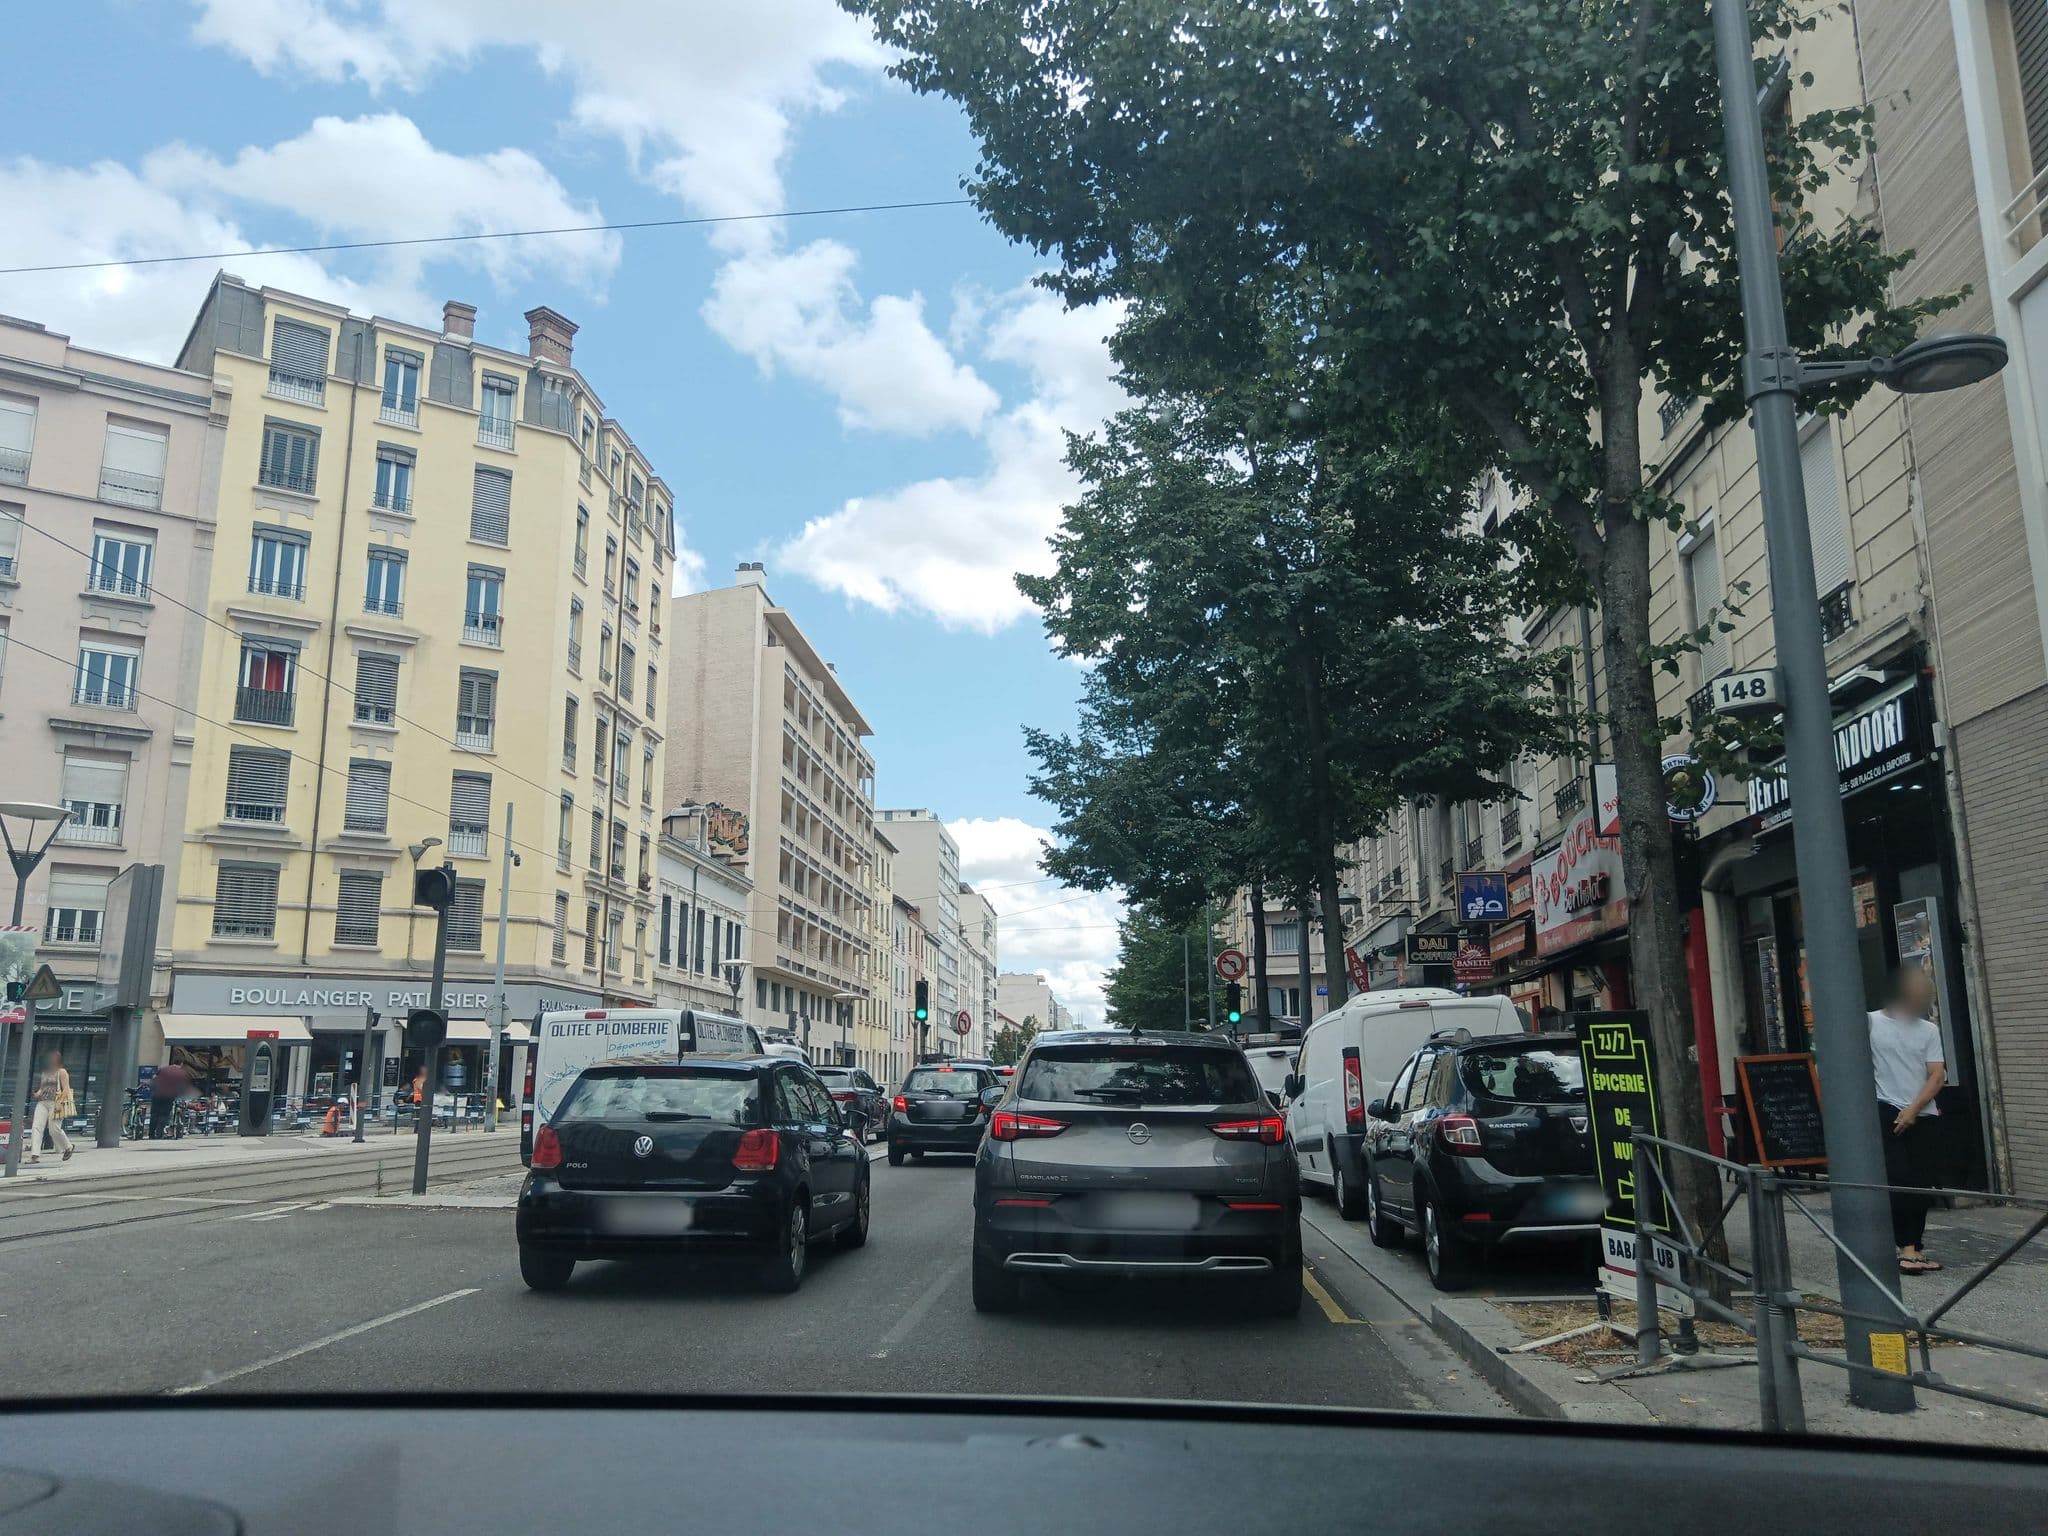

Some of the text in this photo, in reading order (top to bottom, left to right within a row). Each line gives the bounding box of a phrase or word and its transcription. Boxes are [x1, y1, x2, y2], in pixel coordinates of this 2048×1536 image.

[1720, 677, 1767, 702] 148
[1418, 937, 1448, 950] DALI
[1350, 955, 1367, 991] TABAC
[1456, 959, 1493, 967] BANETTE
[230, 987, 488, 1009] BOULANGER PATISIER
[551, 1022, 669, 1037] OLITEC PLOMBERIE
[608, 1038, 667, 1052] Dépannage
[1598, 1031, 1625, 1053] 7J/7
[1592, 1067, 1646, 1094] ÉPICERIE
[1614, 1107, 1632, 1127] DE
[1612, 1141, 1634, 1161] NUI
